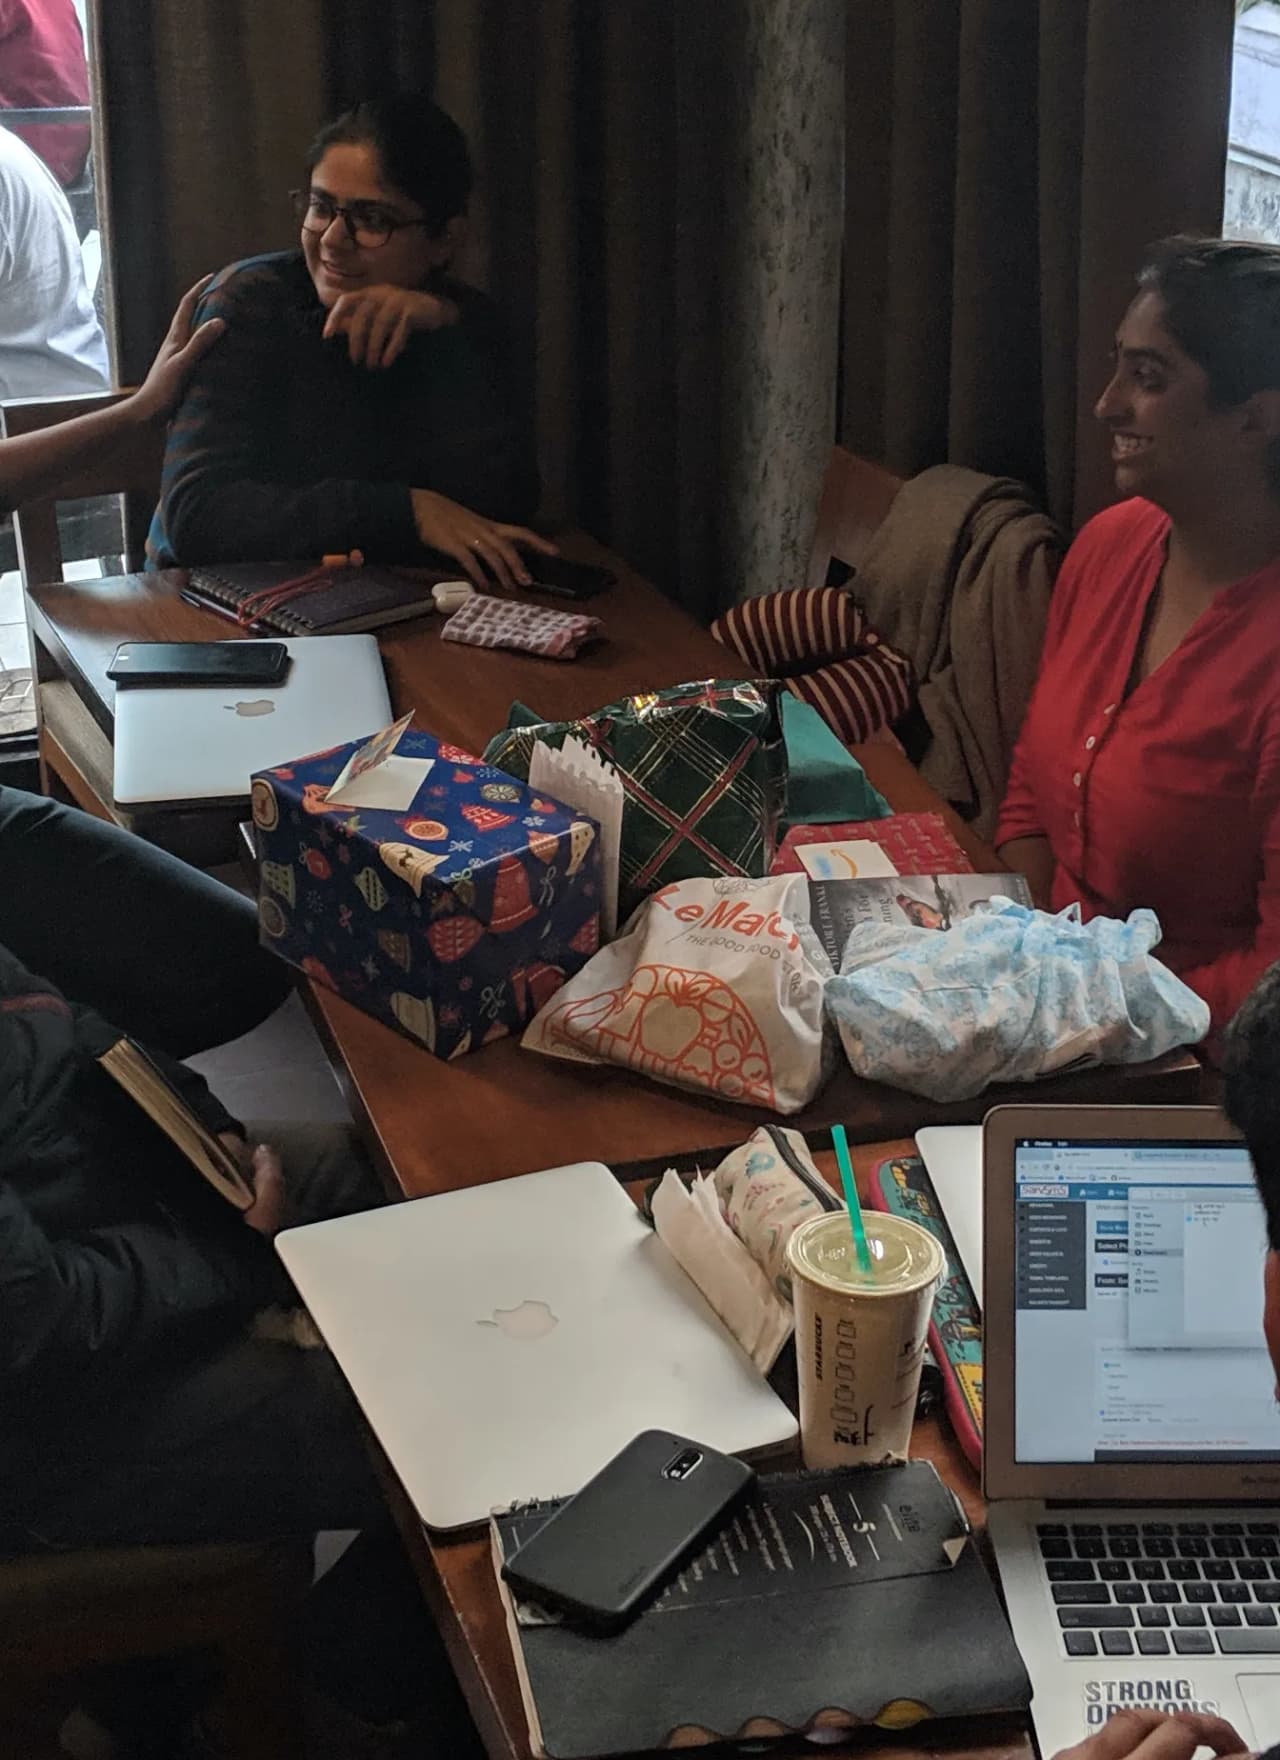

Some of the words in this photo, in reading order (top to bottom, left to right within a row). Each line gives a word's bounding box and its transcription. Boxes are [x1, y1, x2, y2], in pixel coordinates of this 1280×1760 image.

[880, 898, 894, 923] ning
[686, 934, 709, 946] THE
[852, 1521, 877, 1533] 5
[834, 1526, 858, 1568] NOTEBOOK
[1085, 1679, 1192, 1703] STRONG
